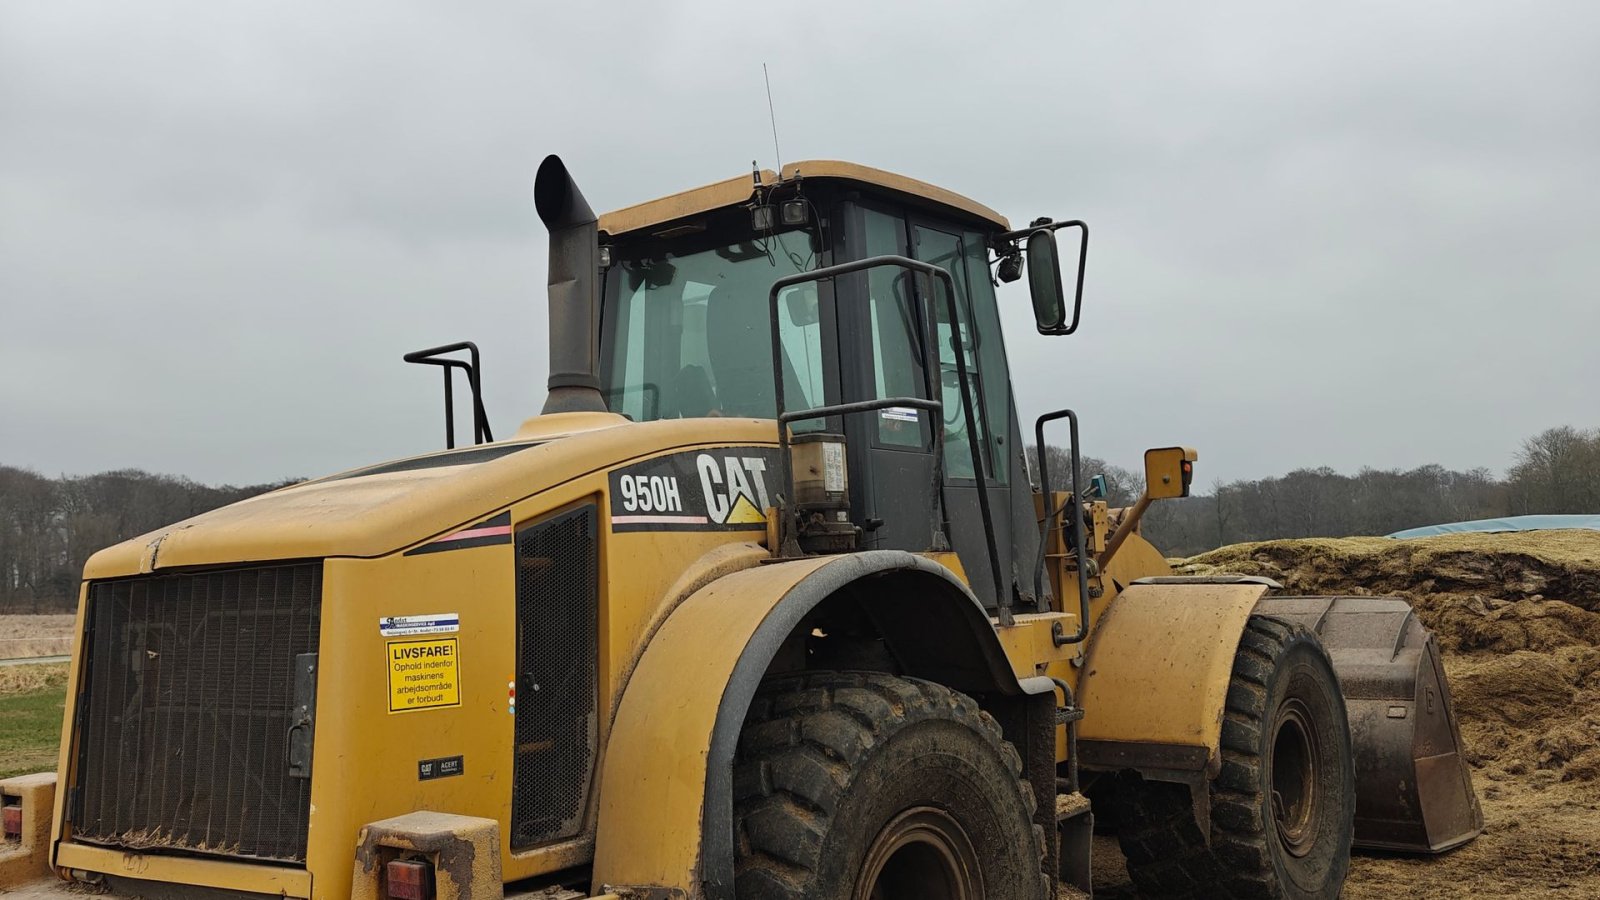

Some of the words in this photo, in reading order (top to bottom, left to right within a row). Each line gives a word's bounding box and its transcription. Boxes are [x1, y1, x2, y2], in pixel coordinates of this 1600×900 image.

[620, 474, 682, 512] 950H
[696, 453, 770, 524] CAT
[394, 645, 453, 659] LIVSFARE!
[394, 662, 422, 672] Ophold
[424, 660, 453, 669] indenfor
[404, 672, 444, 682] maskinens
[397, 681, 452, 695] arbejdsområde
[417, 694, 443, 704] forbudt
[421, 763, 432, 772] CAT
